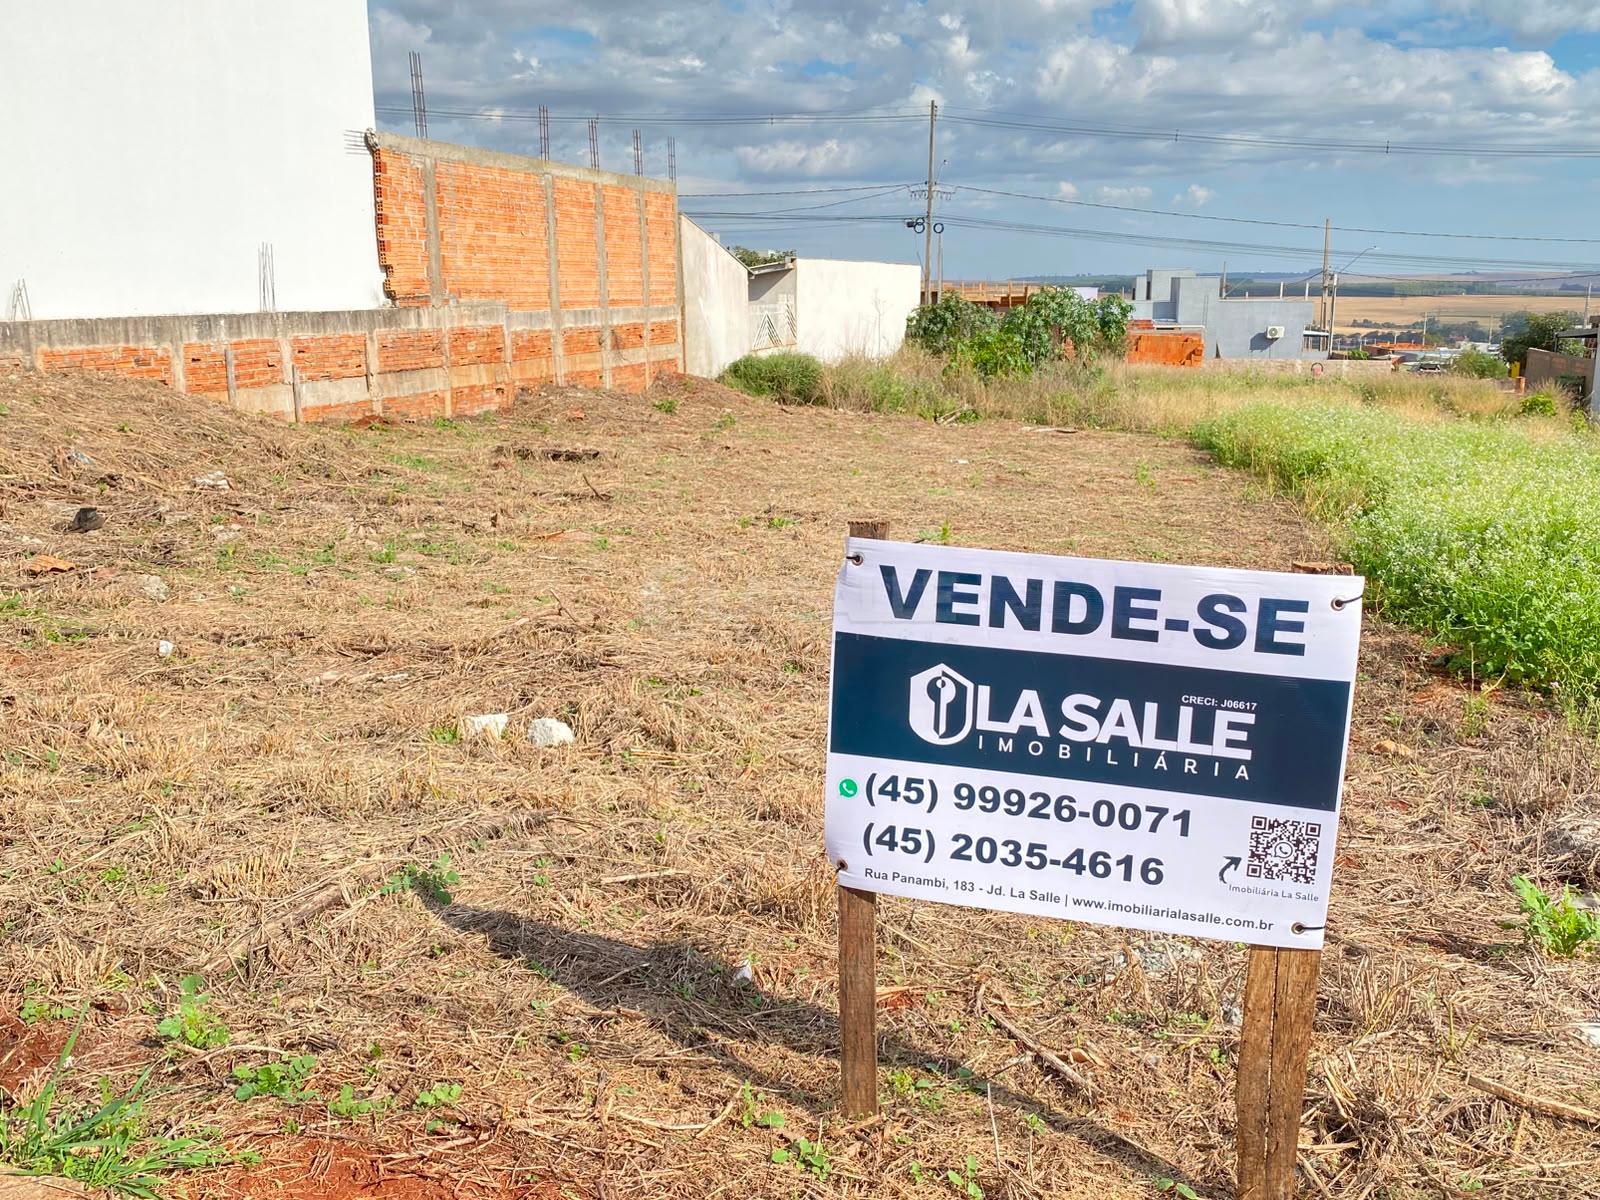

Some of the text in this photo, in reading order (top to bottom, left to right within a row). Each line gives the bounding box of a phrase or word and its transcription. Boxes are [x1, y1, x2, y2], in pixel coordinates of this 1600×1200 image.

[879, 565, 1309, 656] VENDE-SE
[976, 685, 1256, 760] LA SALLE
[1181, 695, 1257, 710] CRECI: J06617
[978, 735, 1249, 780] IMOBILIÁRIA
[865, 773, 1192, 837] (45) 99926-0071
[863, 822, 1164, 885] (45) 2035-4616
[865, 868, 888, 880] Rua
[892, 871, 949, 890] Panambi,
[953, 880, 975, 892] 183
[987, 884, 1006, 896] Jd.
[1010, 887, 1025, 899] La
[1029, 889, 1061, 904] Salle
[1072, 897, 1275, 931] www.imobiliarialasalle.com.br
[1229, 884, 1319, 902] Imobiliária La Salle
